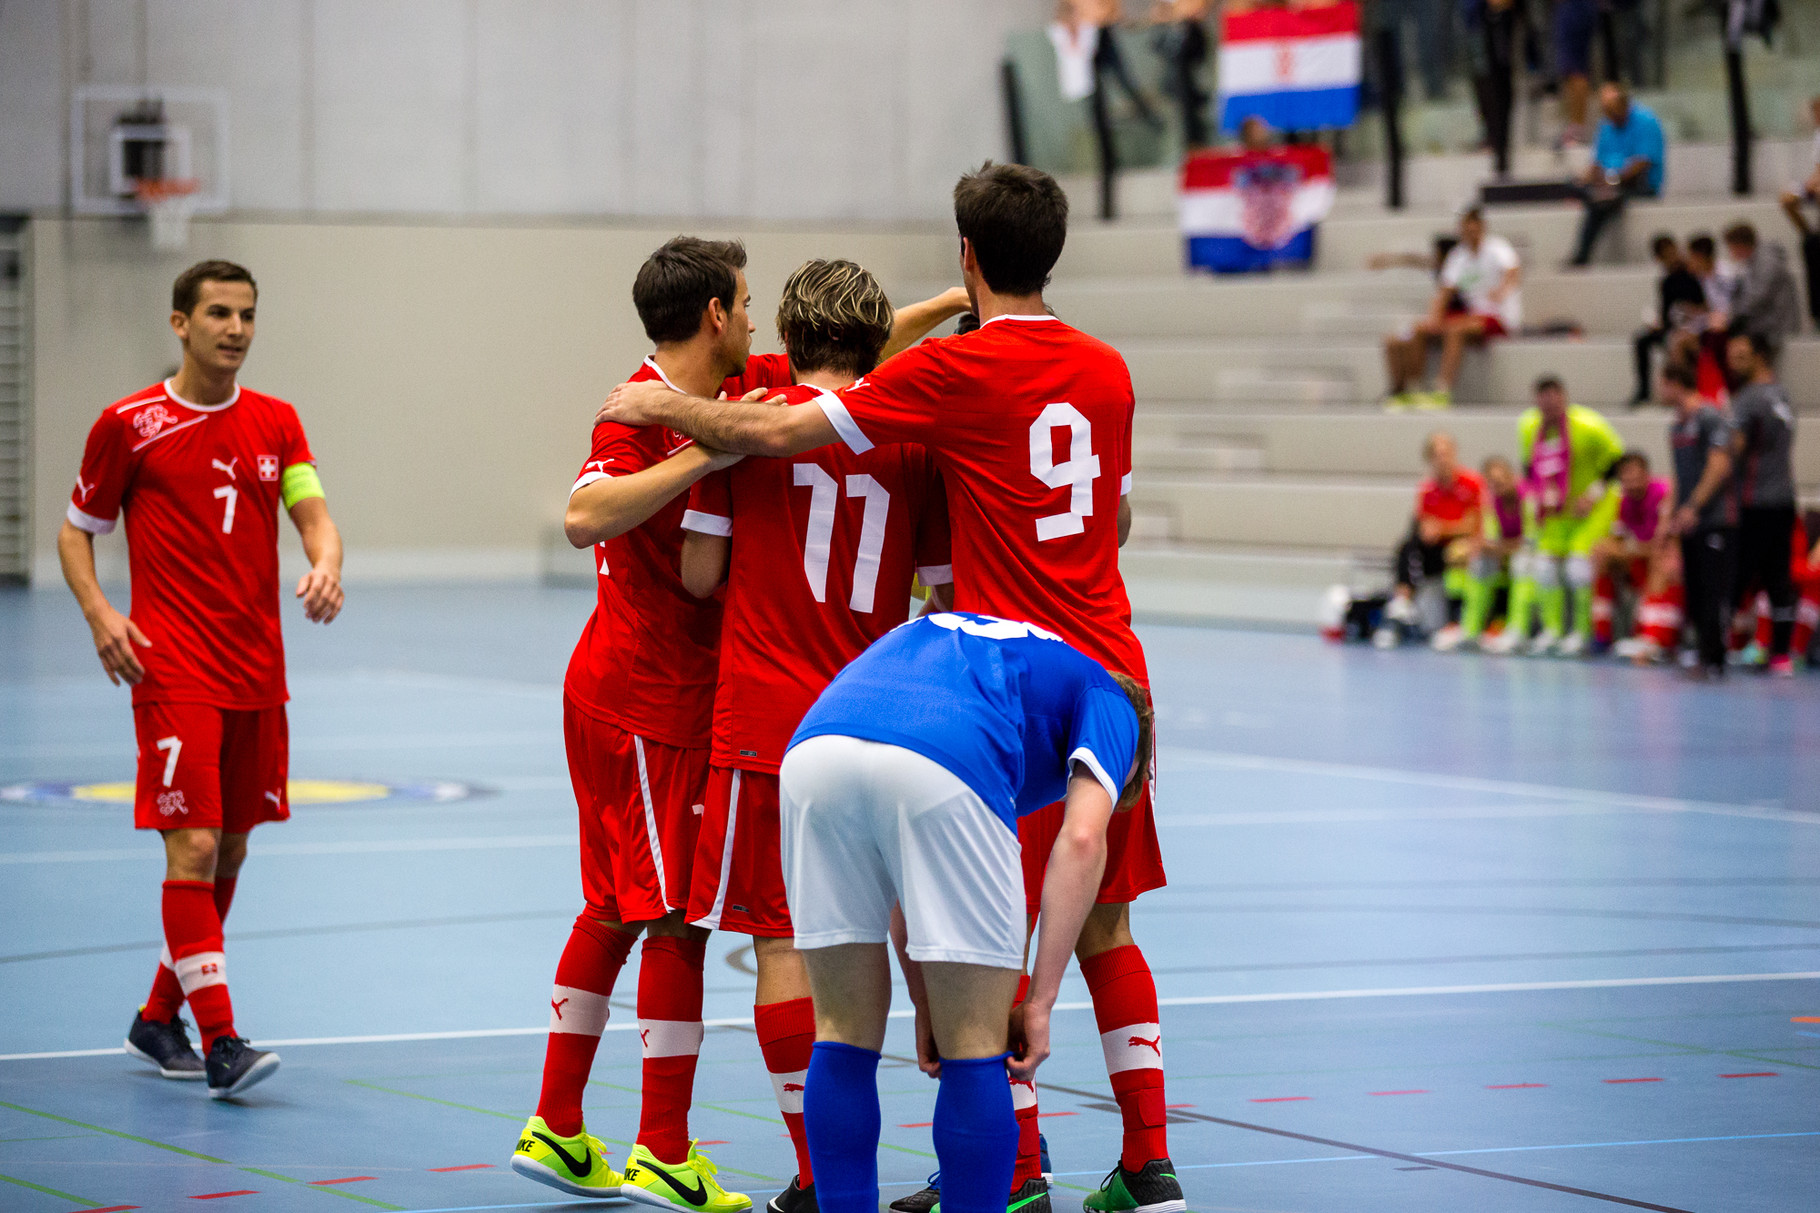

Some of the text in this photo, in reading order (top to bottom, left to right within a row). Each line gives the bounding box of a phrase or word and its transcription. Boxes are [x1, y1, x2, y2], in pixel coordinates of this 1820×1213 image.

[213, 485, 238, 534] 7
[1029, 402, 1101, 542] 9
[793, 463, 890, 613] 11
[156, 735, 183, 788] 7
